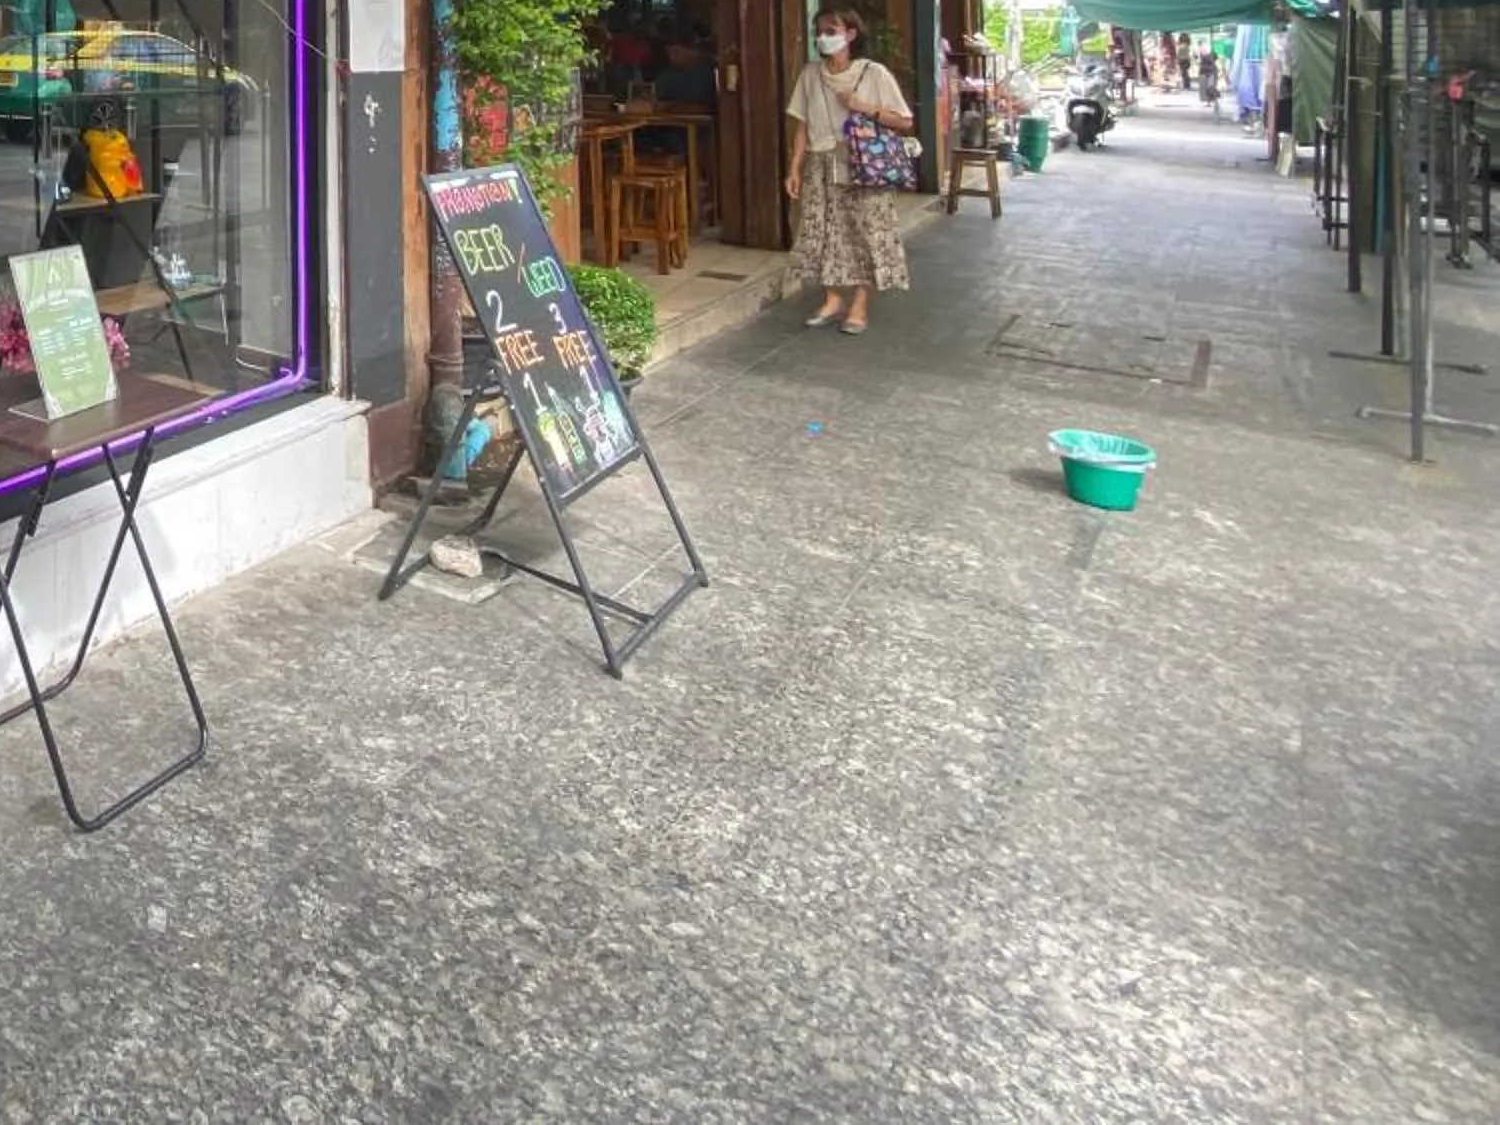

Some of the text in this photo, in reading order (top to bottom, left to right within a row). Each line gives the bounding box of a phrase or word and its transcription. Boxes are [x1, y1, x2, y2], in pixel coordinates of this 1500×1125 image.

[453, 223, 516, 276] BEER
[485, 289, 519, 332] 2
[548, 302, 568, 334] 3
[494, 329, 545, 375] FREE
[551, 329, 598, 371] FREE
